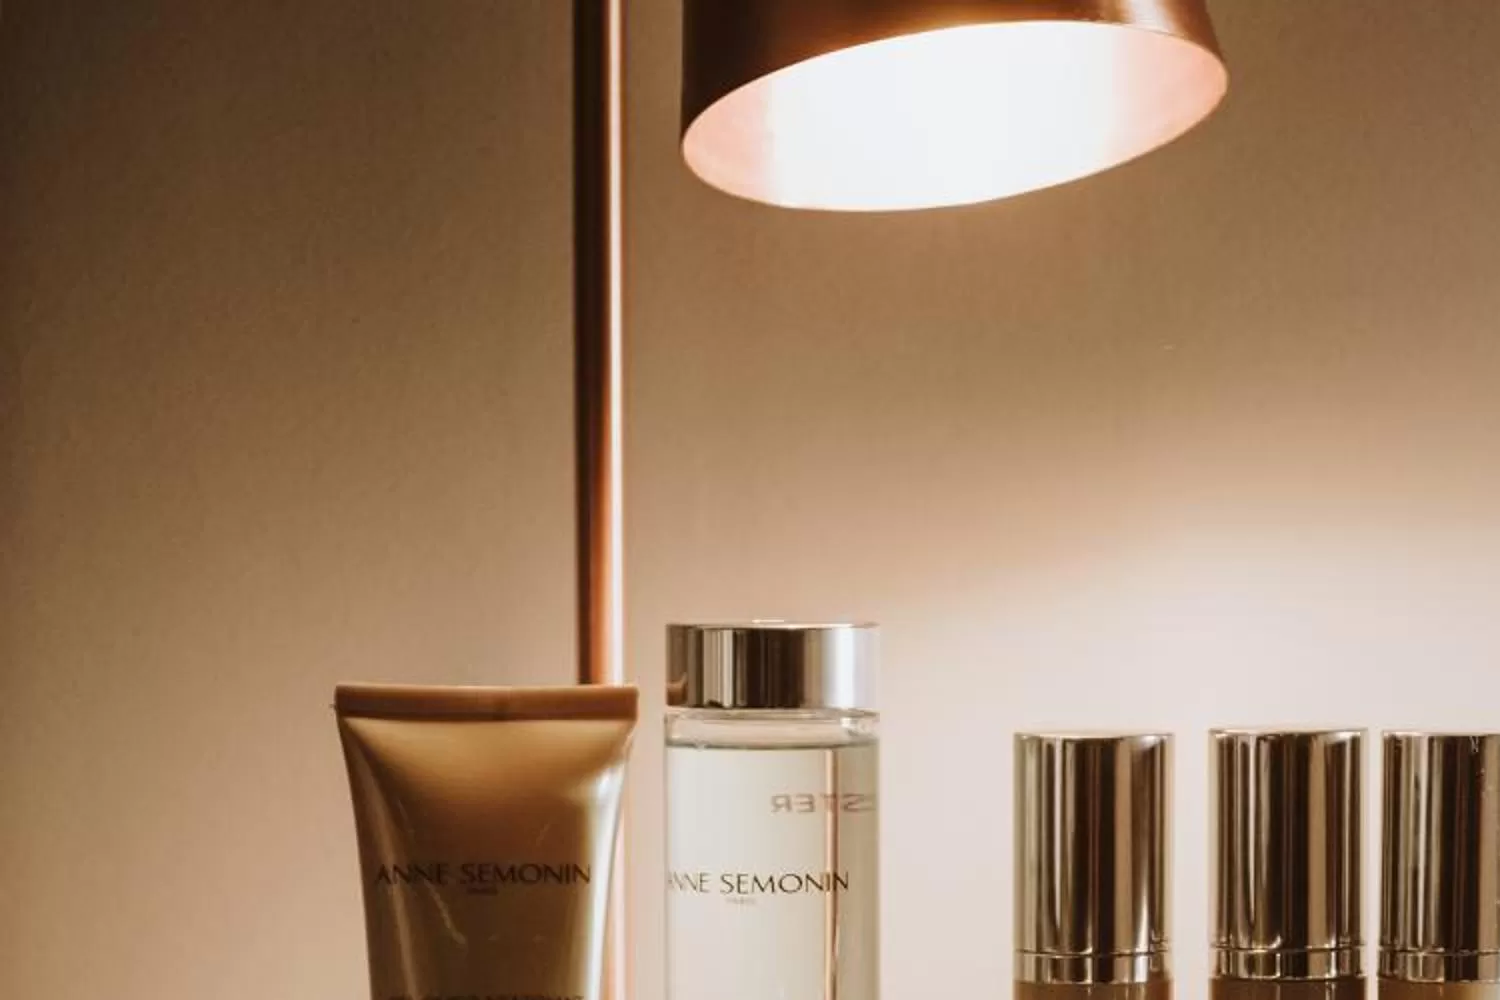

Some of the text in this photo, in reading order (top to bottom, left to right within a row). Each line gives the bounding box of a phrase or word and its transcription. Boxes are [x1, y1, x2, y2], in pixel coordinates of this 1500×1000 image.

[376, 863, 592, 886] ANNE SEMONIN
[719, 870, 850, 896] SEMONIN
